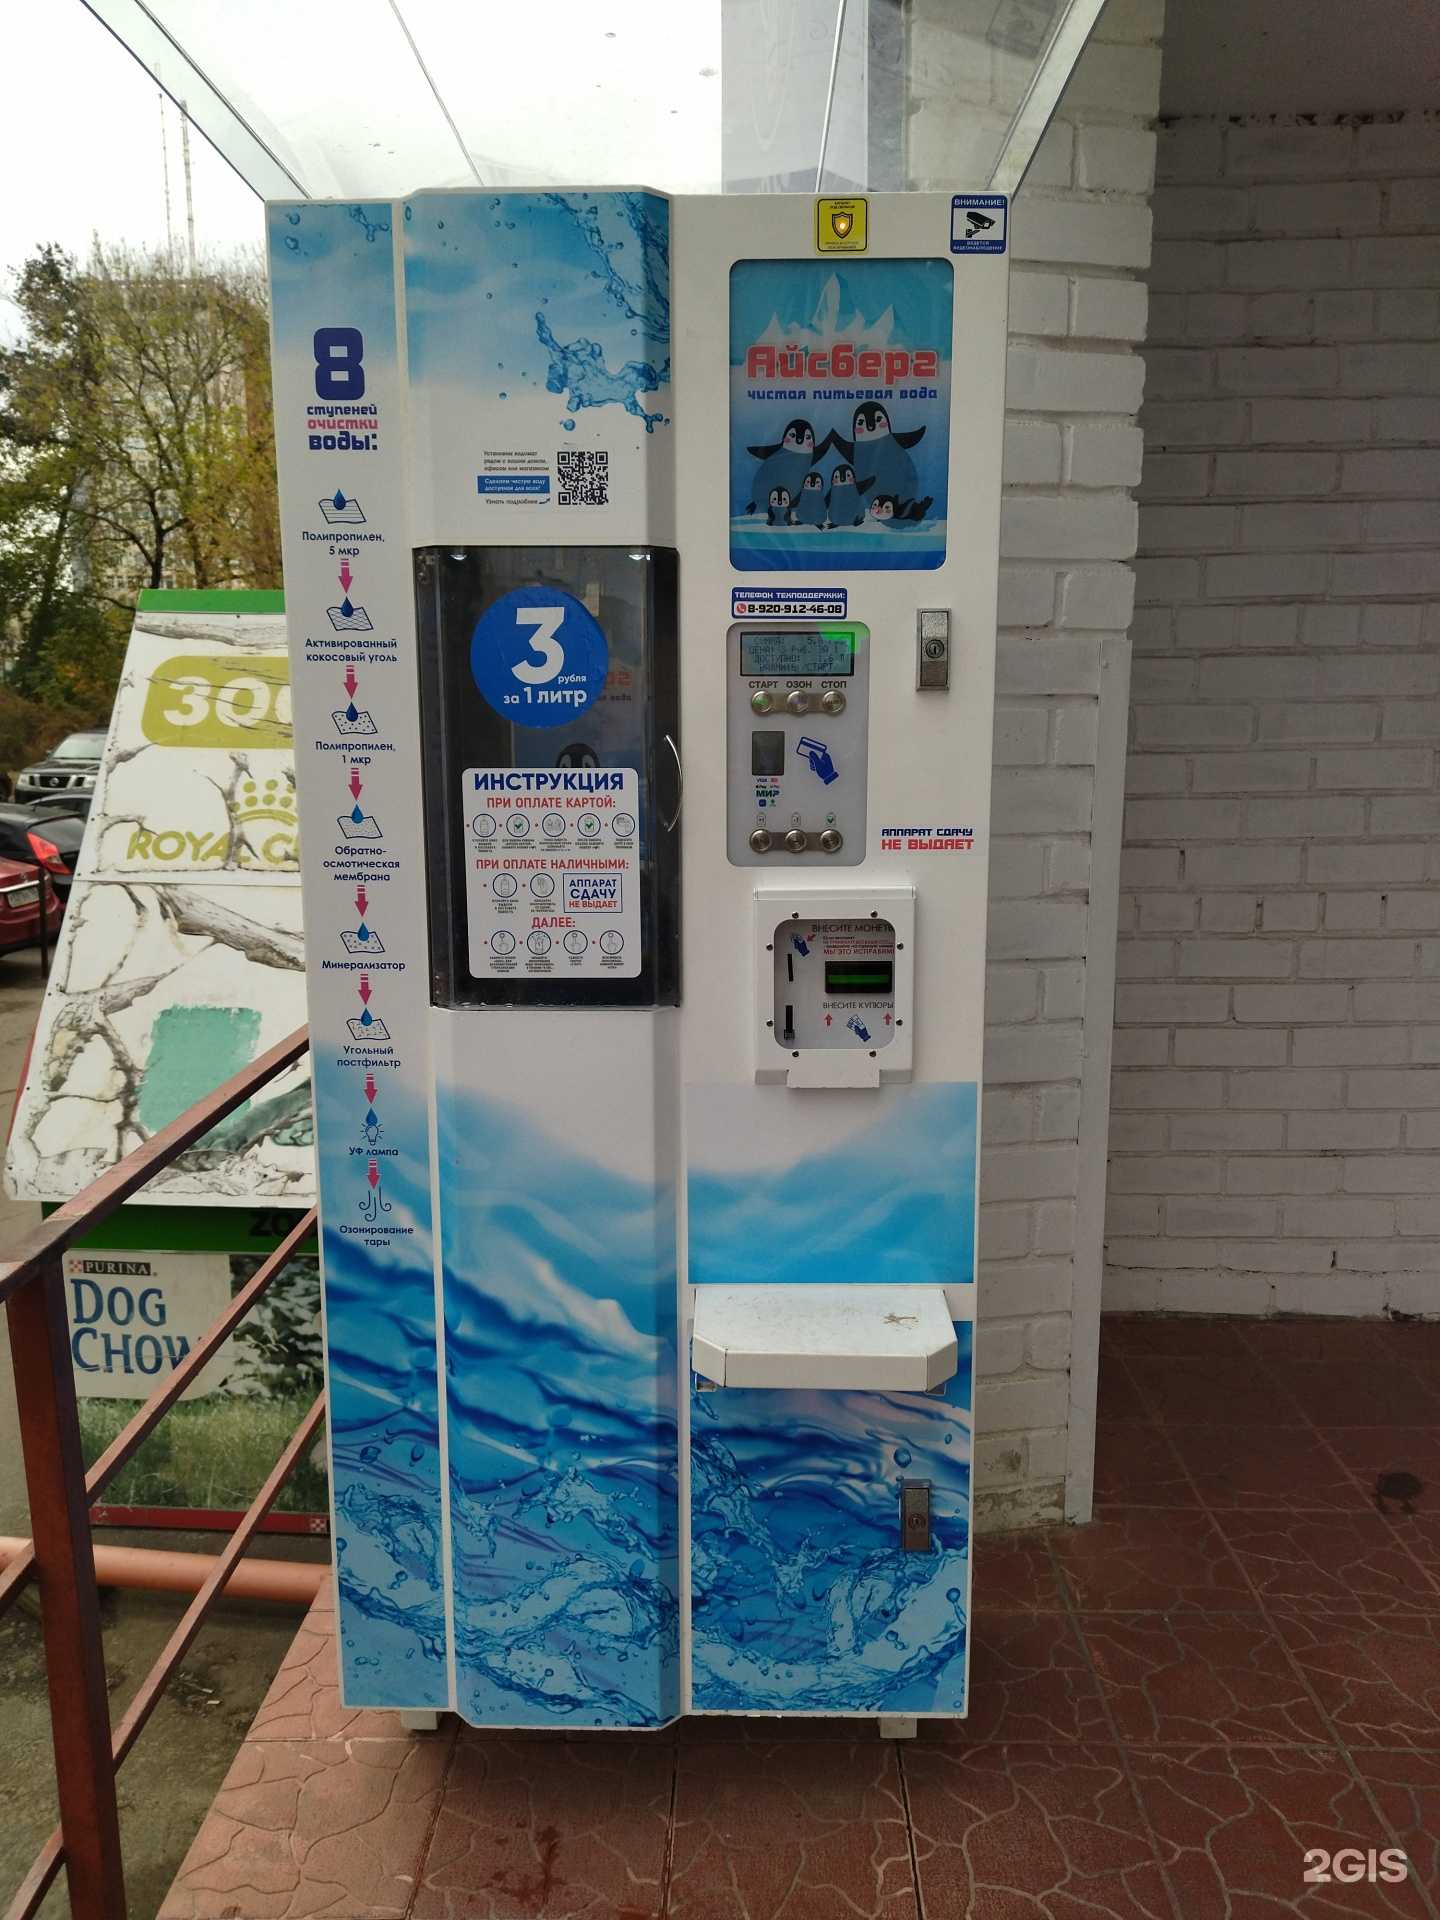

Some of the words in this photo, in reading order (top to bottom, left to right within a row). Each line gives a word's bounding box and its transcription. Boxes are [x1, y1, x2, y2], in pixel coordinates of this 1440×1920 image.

[954, 198, 1004, 206] ВНИМАНИЕ!
[314, 328, 365, 400] 8
[746, 344, 940, 385] Айсберг
[747, 389, 806, 400] чистая
[813, 389, 893, 400] питьевая
[900, 386, 937, 399] вода
[307, 404, 377, 417] ступеней
[308, 419, 378, 430] очистки
[309, 431, 377, 450] воды:
[302, 531, 385, 543] Полипропилен,
[329, 546, 335, 555] 5
[338, 547, 360, 557] мкр
[734, 591, 774, 599] ТЕЛЕФОН
[747, 604, 842, 614] 8-920-912-46-08
[305, 638, 398, 650] Активированный
[511, 606, 565, 685] 3
[558, 673, 587, 684] рубля
[306, 652, 365, 662] кокосовый
[368, 653, 398, 664] уголь
[748, 681, 779, 689] СТАРТ
[786, 681, 813, 689] ОЗОН
[821, 681, 847, 689] СТОП
[503, 693, 519, 704] за
[523, 687, 532, 704] 1
[537, 688, 587, 708] литр
[315, 741, 396, 753] Полипропилен,
[342, 755, 347, 764] 1
[350, 756, 371, 766] мкр
[474, 773, 624, 793] ИНСТРУКЦИЯ
[487, 797, 511, 808] ПРИ
[516, 797, 562, 808] ОПЛАТЕ
[566, 795, 616, 808] КАРТОЙ:
[882, 828, 933, 836] АППАРАТ
[936, 828, 973, 836] СДАЧУ
[882, 839, 902, 850] НЕ
[908, 839, 974, 850] ВЫДАЕТ
[334, 846, 387, 857] Обратно-
[323, 860, 400, 869] осмотическая
[476, 859, 499, 869] ПРИ
[503, 859, 547, 869] ОПЛАТЕ
[550, 859, 629, 869] НАЛИЧНЫМИ:
[334, 871, 391, 883] мембрана
[569, 879, 617, 888] АППАРАТ
[570, 888, 617, 900] СДАЧУ
[569, 901, 581, 909] НЕ
[582, 900, 618, 909] ВЫДАЕТ
[531, 917, 576, 929] ДАЛЕЕ:
[322, 960, 406, 972] Минерализатор
[823, 1001, 857, 1009] ВНЕСИТЕ
[858, 1001, 894, 1009] КУПЮРЫ
[343, 1045, 394, 1055] Угольный
[336, 1058, 401, 1069] постфильтр
[349, 1147, 364, 1156] УФ
[366, 1148, 399, 1156] лампа
[339, 1225, 414, 1236] Озонирование
[364, 1238, 391, 1247] тары
[85, 1262, 148, 1274] PURINA
